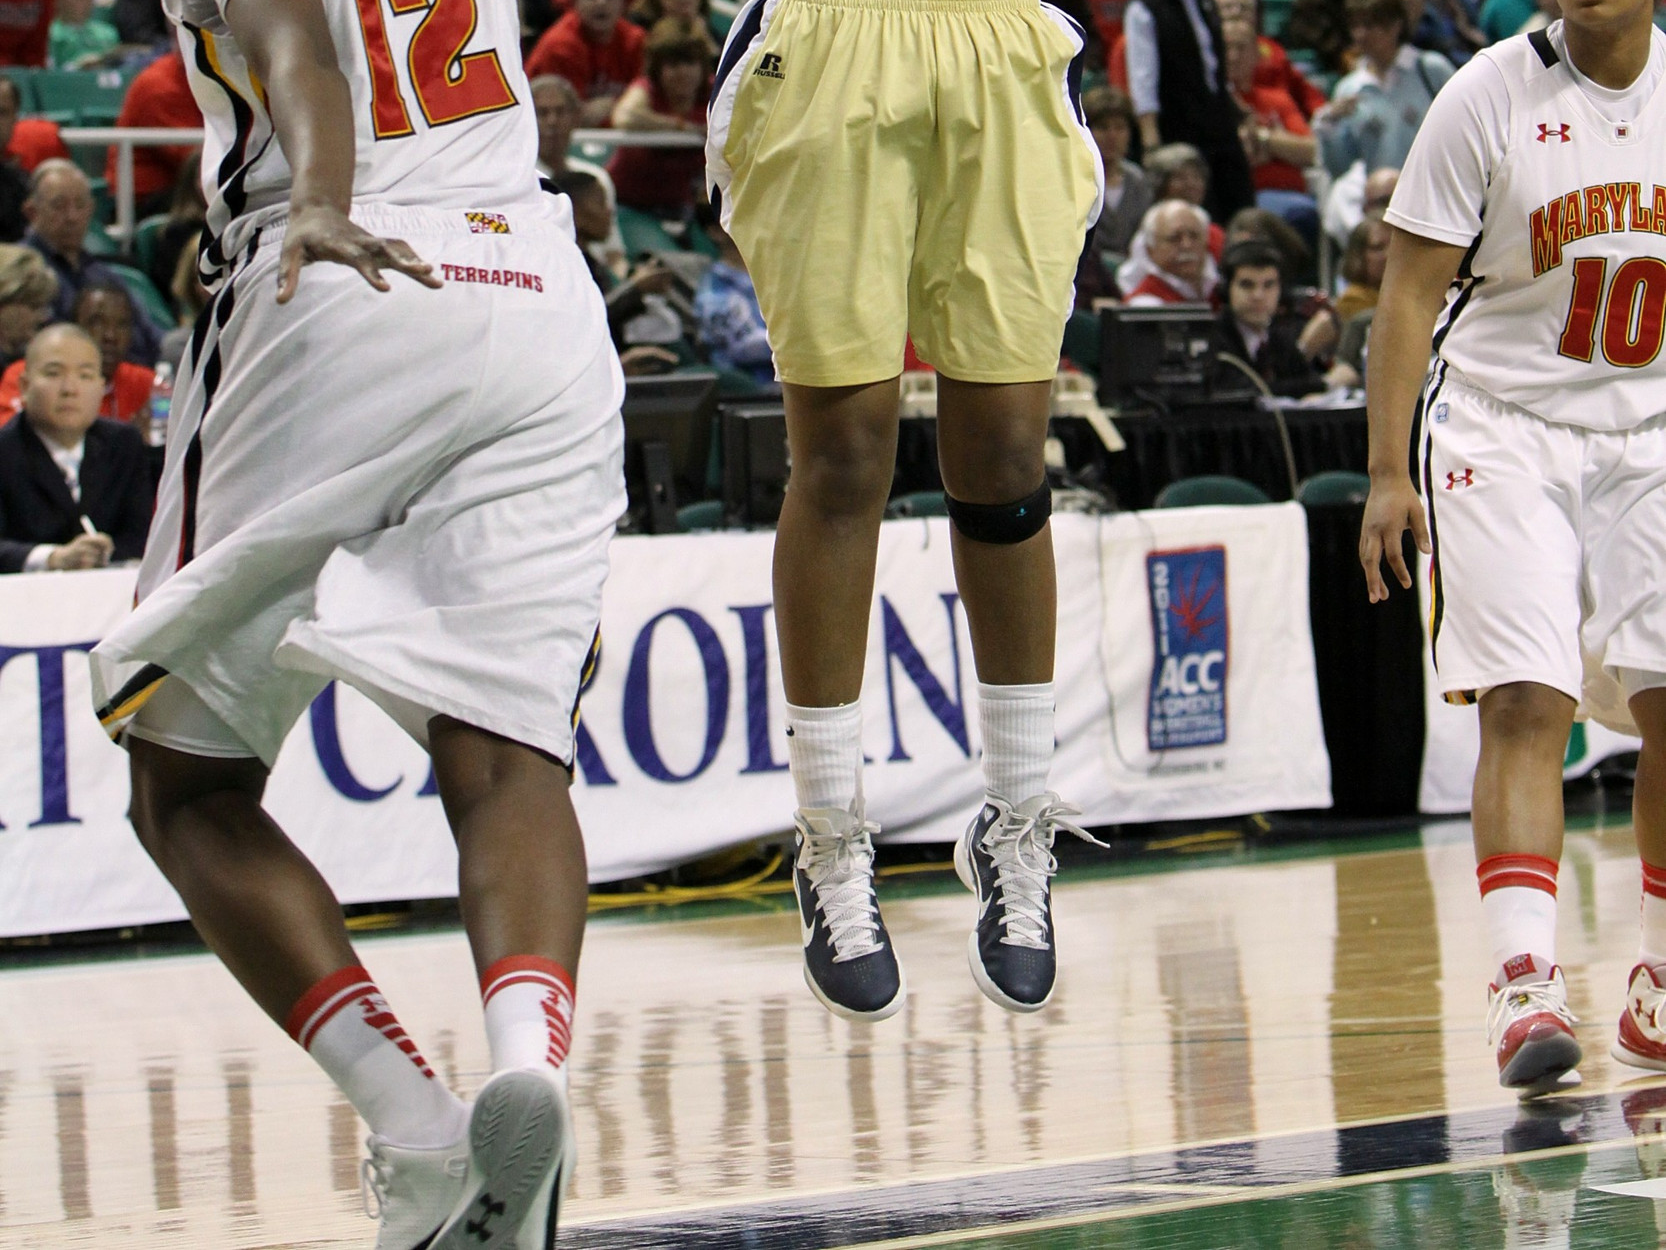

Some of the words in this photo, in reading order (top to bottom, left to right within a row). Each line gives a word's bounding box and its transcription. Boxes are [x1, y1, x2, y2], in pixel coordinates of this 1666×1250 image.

[441, 263, 544, 293] TERRAPINS
[1557, 256, 1666, 368] 10
[1157, 650, 1224, 696] ACC
